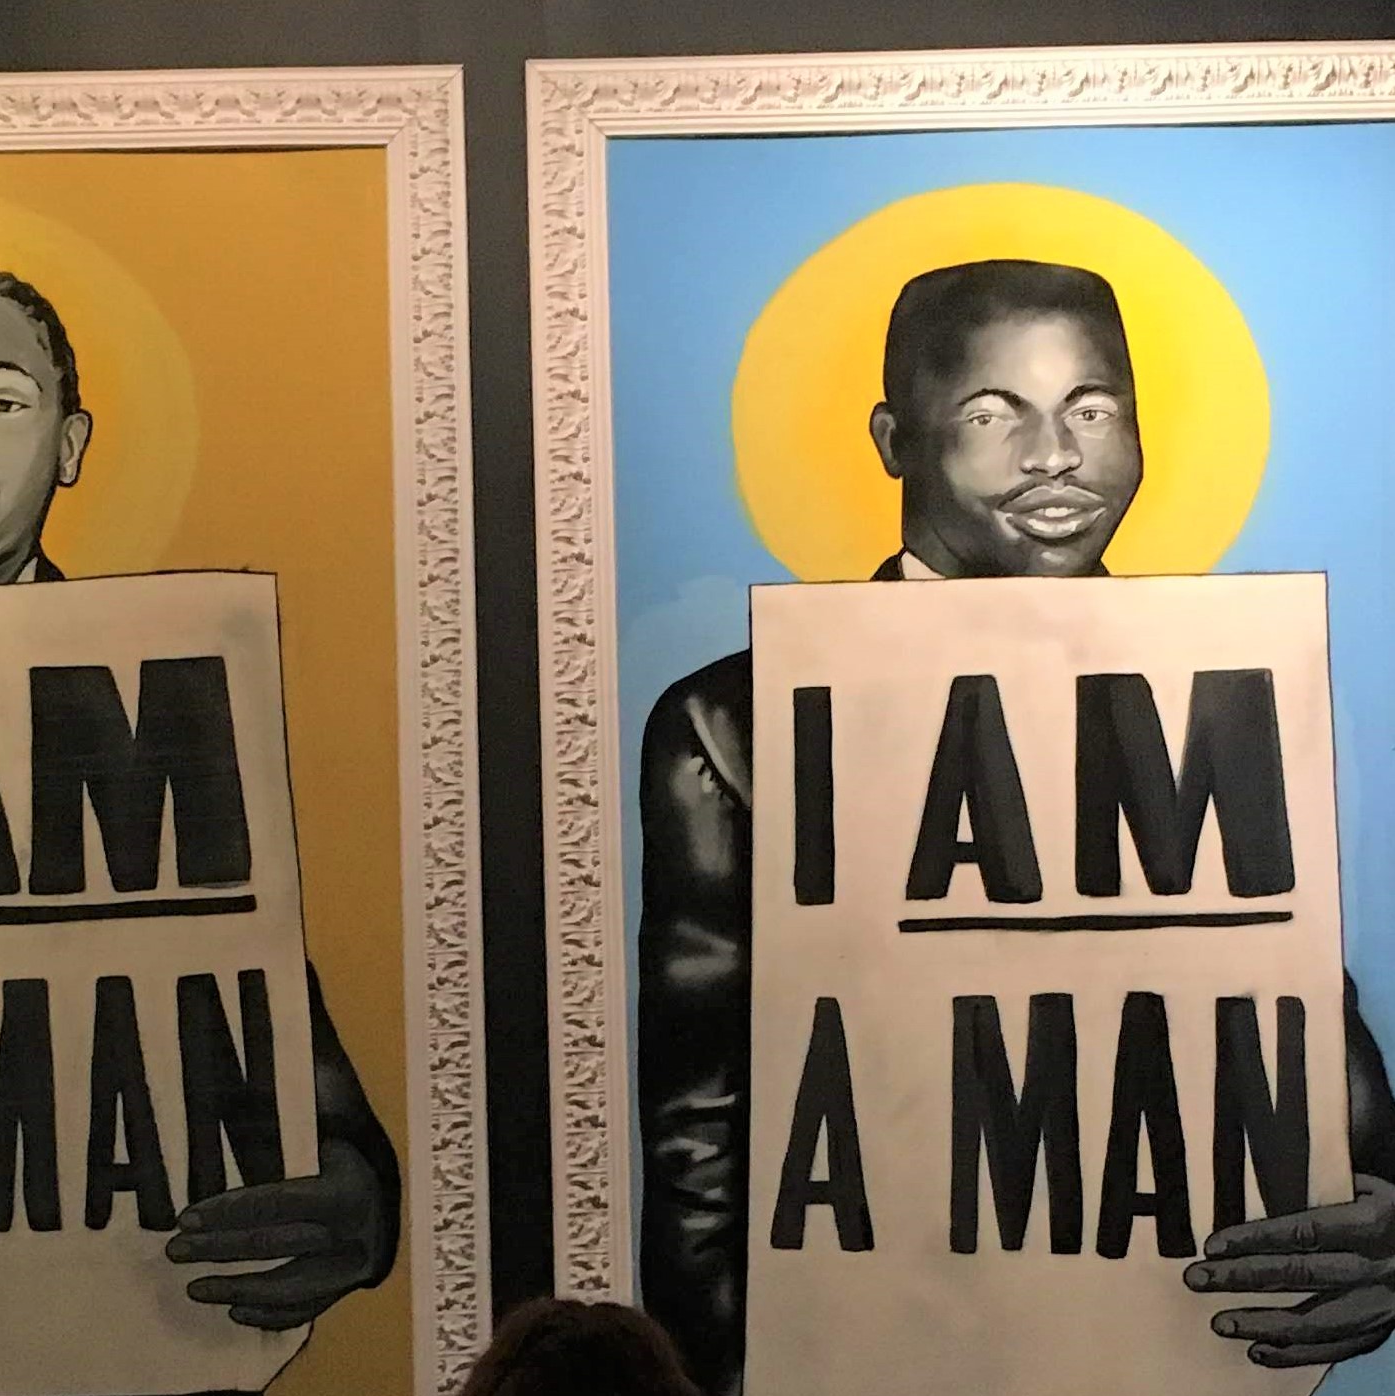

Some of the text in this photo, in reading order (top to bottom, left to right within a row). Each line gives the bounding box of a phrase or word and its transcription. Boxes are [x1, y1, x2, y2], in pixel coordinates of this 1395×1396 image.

[793, 668, 1295, 905] I AM
[770, 991, 1311, 1259] A MAN
